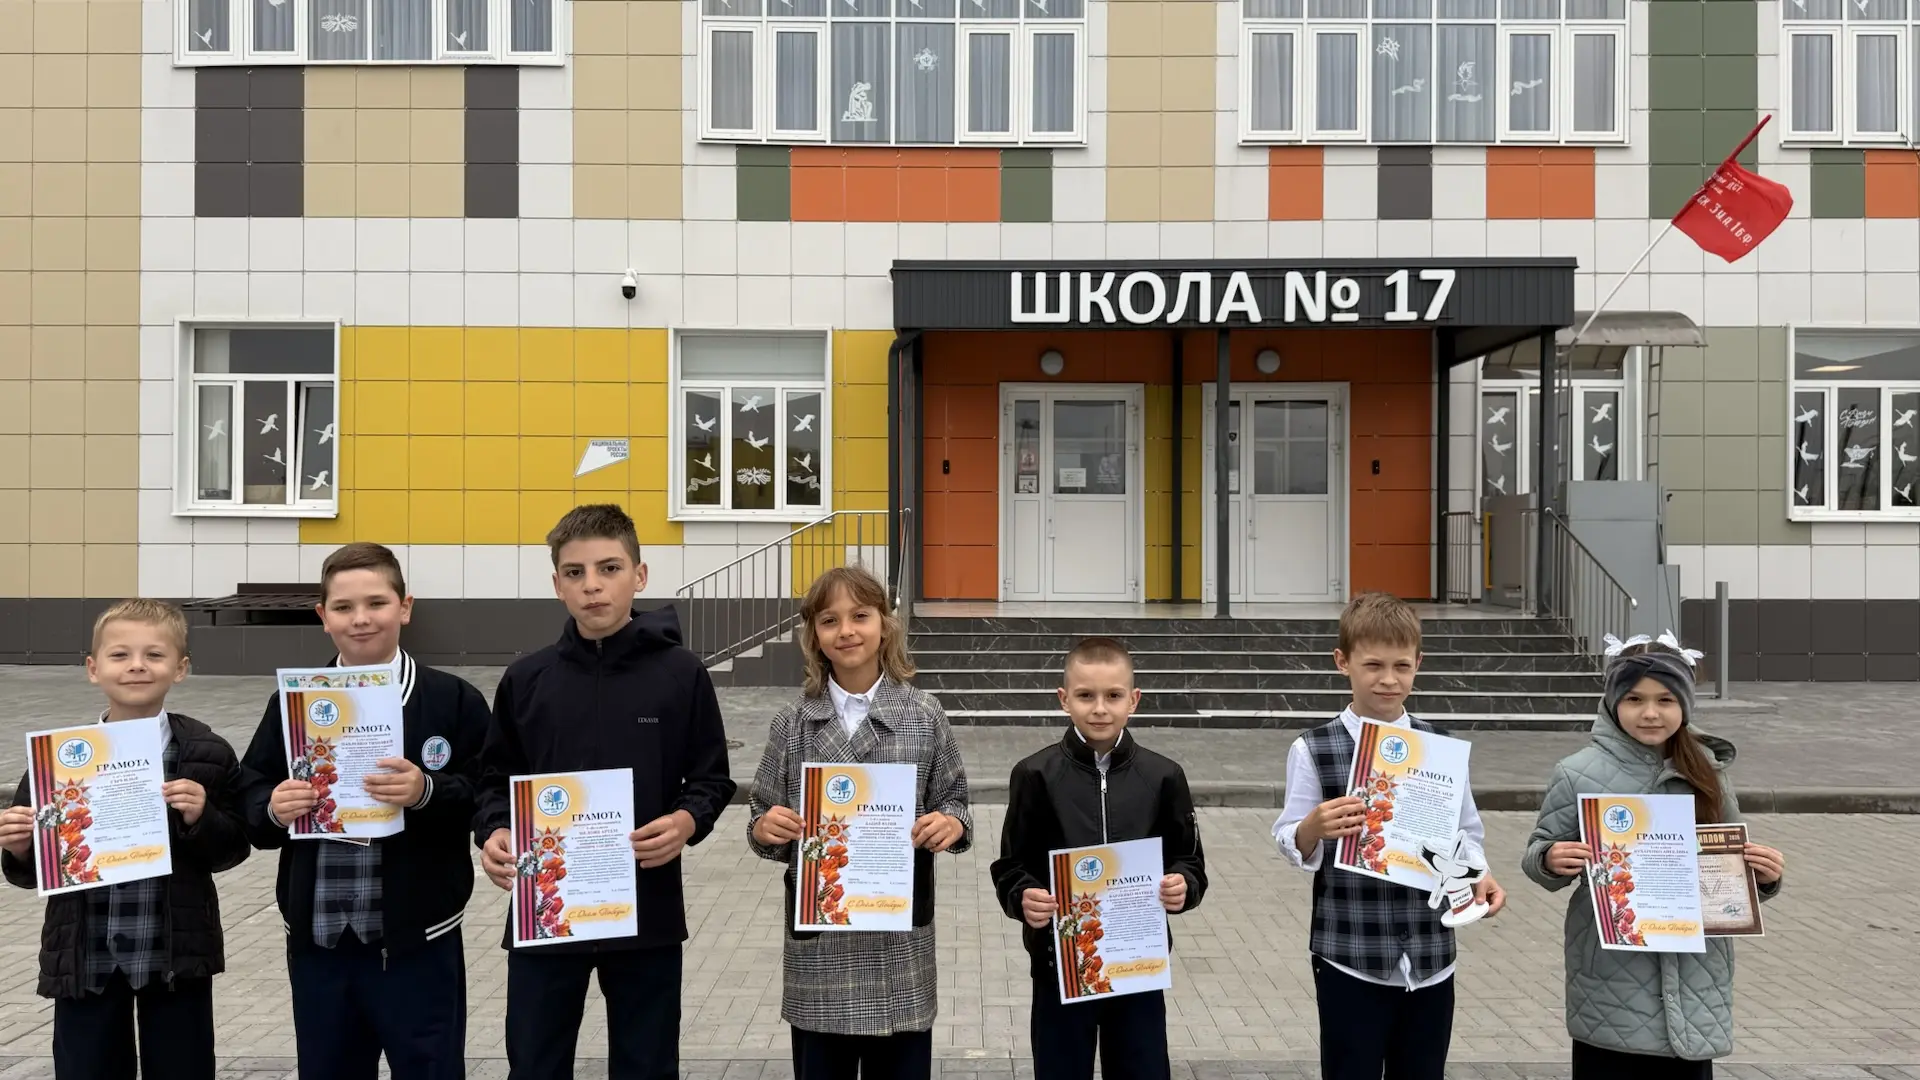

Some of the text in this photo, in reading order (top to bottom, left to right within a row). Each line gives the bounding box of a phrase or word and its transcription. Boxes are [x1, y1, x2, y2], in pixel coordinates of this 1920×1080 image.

[1010, 269, 1456, 324] ШКОЛА № 17
[325, 714, 335, 722] 17
[342, 724, 391, 733] ГРАМОТА
[77, 753, 88, 762] 17
[1394, 751, 1404, 760] 17
[96, 759, 150, 772] ГРАМОТА
[1407, 767, 1453, 784] ГРАМОТА
[842, 791, 851, 799] 17
[555, 801, 565, 810] 17
[857, 804, 904, 812] ГРАМОТА
[572, 811, 622, 822] ГРАМОТА
[1620, 820, 1629, 828] 17
[1636, 833, 1685, 841] ГРАМОТА
[1090, 869, 1099, 877] 17
[1106, 875, 1152, 886] ГРАМОТА
